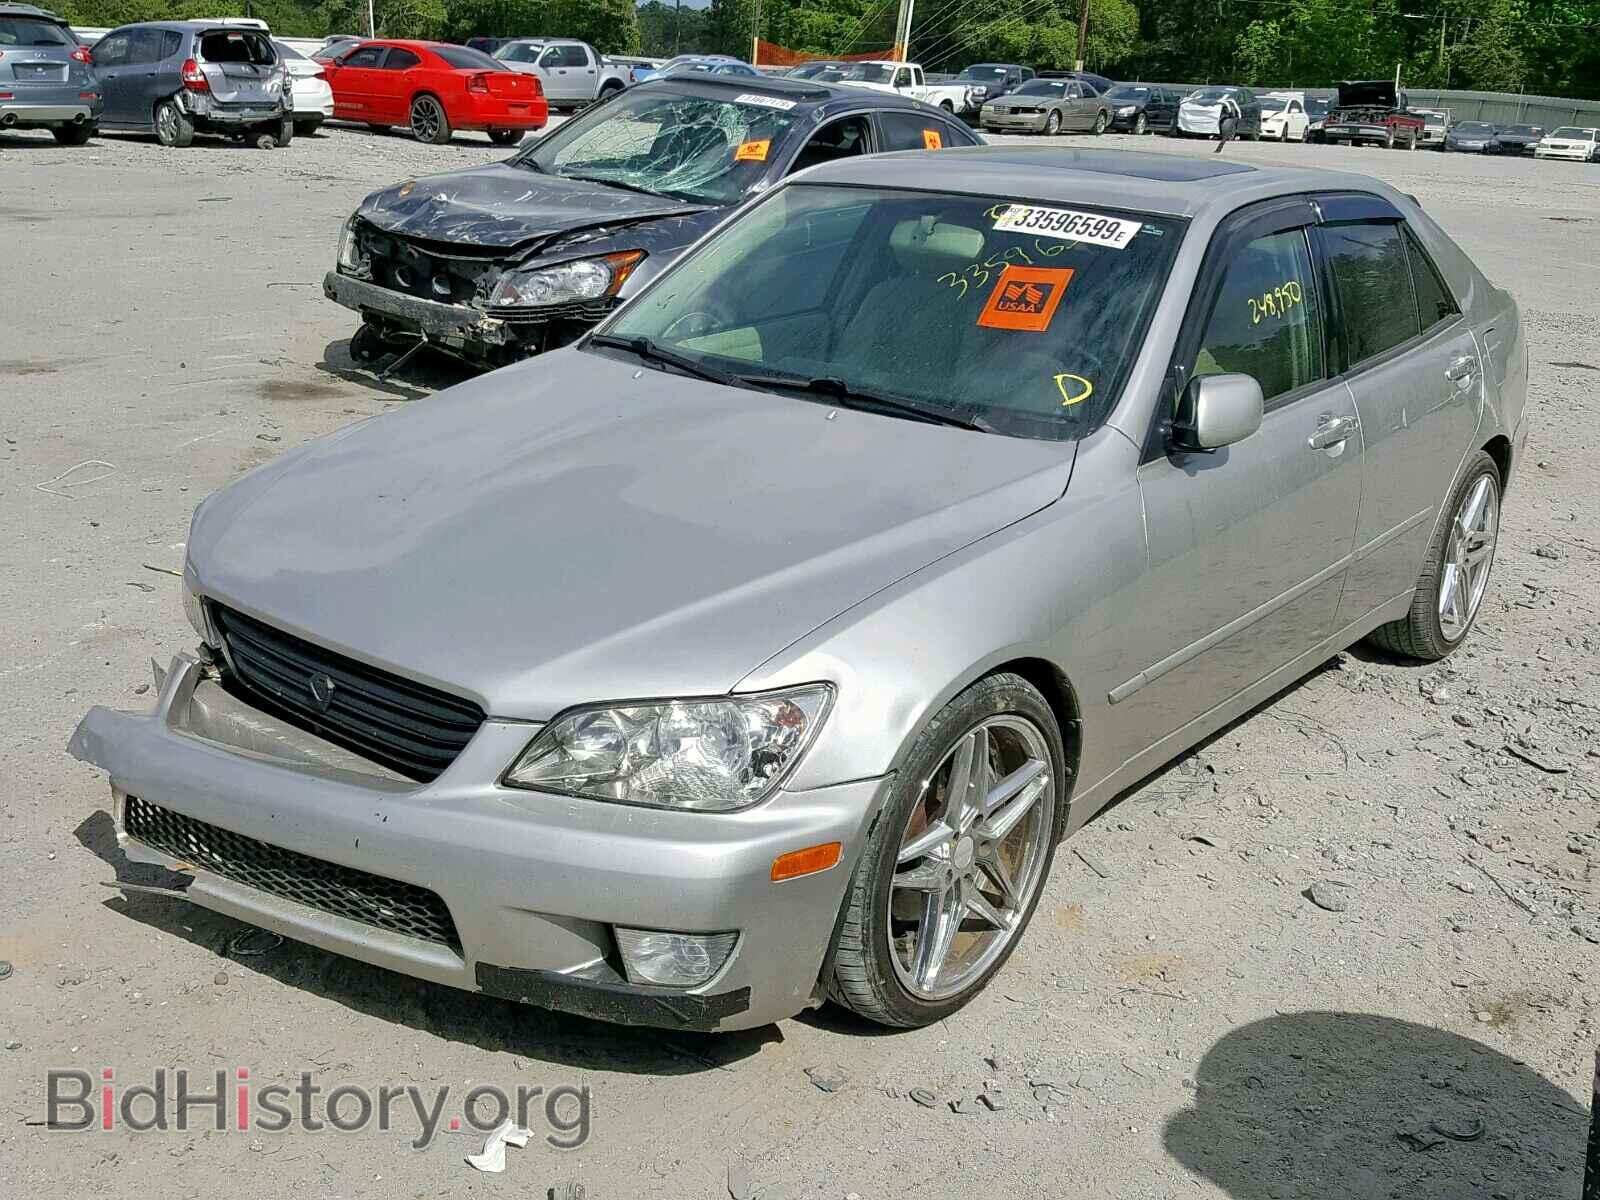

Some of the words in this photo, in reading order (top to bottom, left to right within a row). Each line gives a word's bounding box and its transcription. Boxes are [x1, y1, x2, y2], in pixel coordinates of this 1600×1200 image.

[997, 300, 1036, 313] USAA
[1247, 281, 1302, 324] 248,950
[1053, 373, 1094, 406] D
